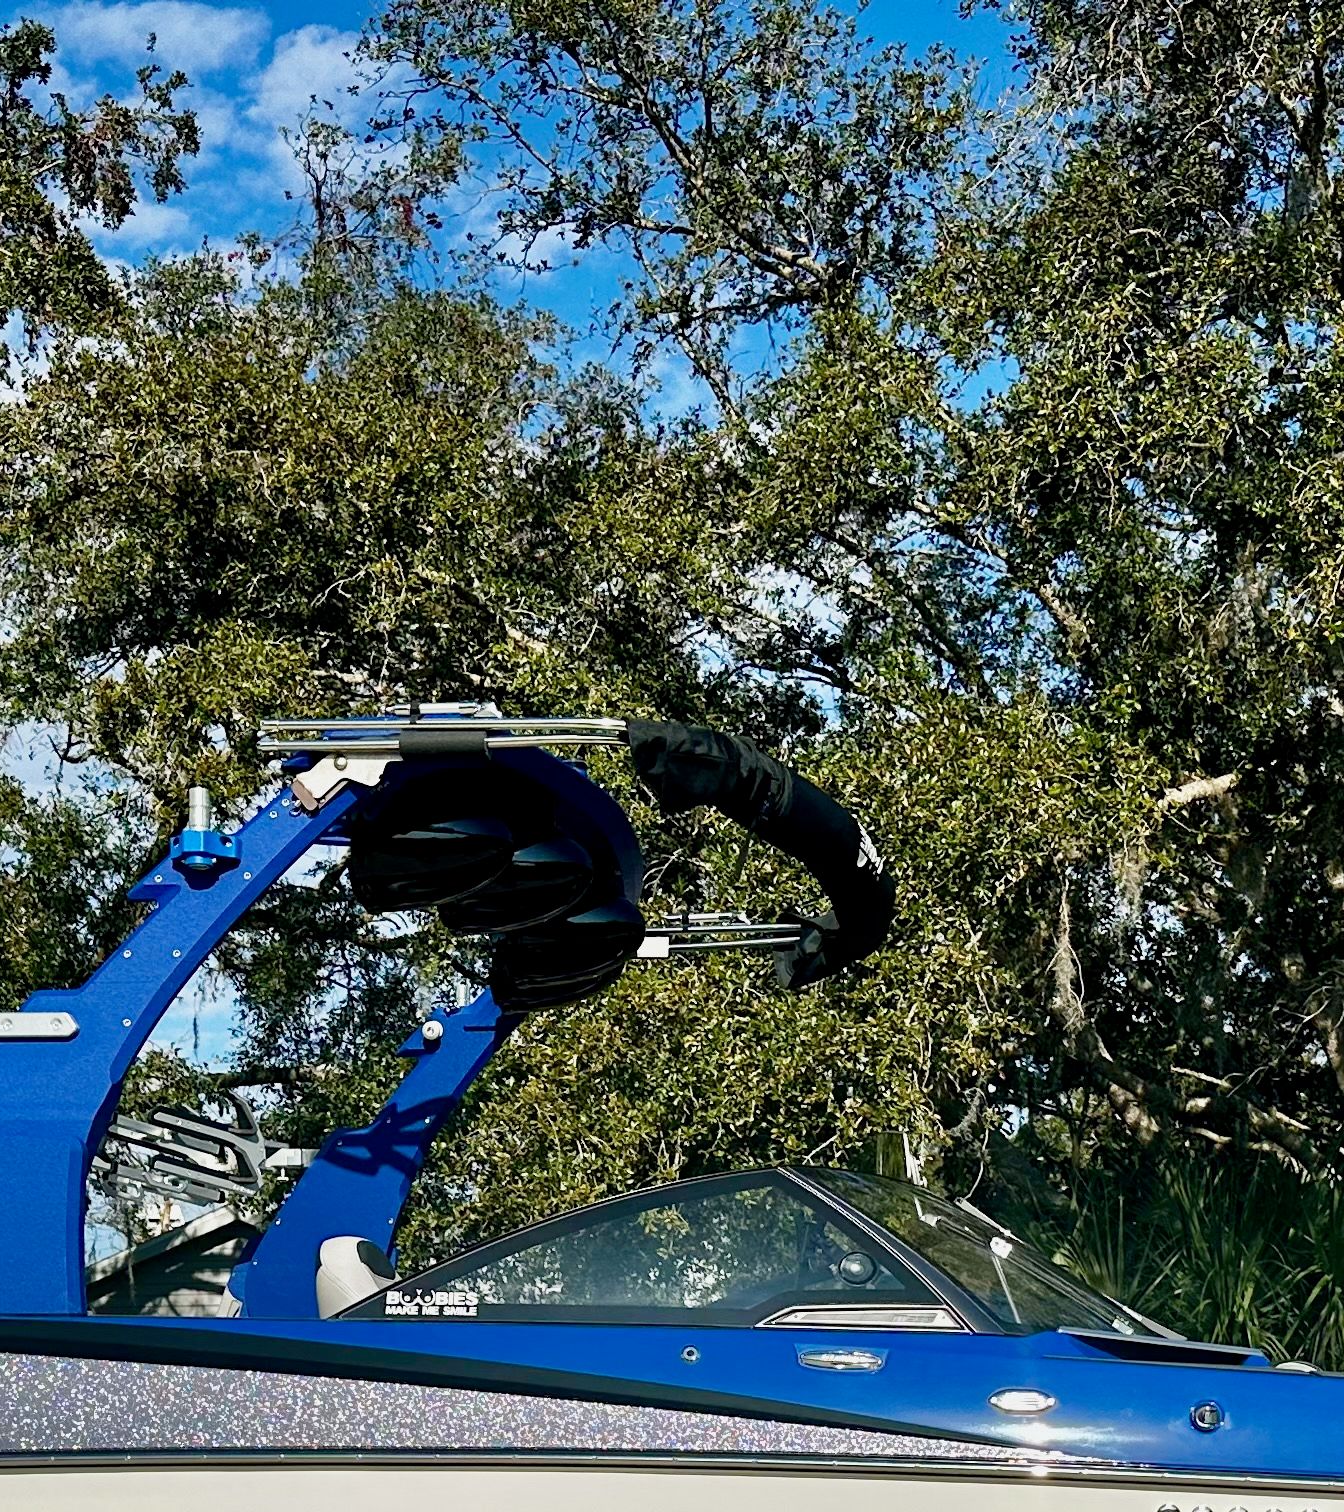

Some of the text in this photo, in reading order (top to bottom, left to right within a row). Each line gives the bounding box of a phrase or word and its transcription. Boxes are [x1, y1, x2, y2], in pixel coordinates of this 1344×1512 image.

[384, 1305, 478, 1317] MAKE ME SMILE
